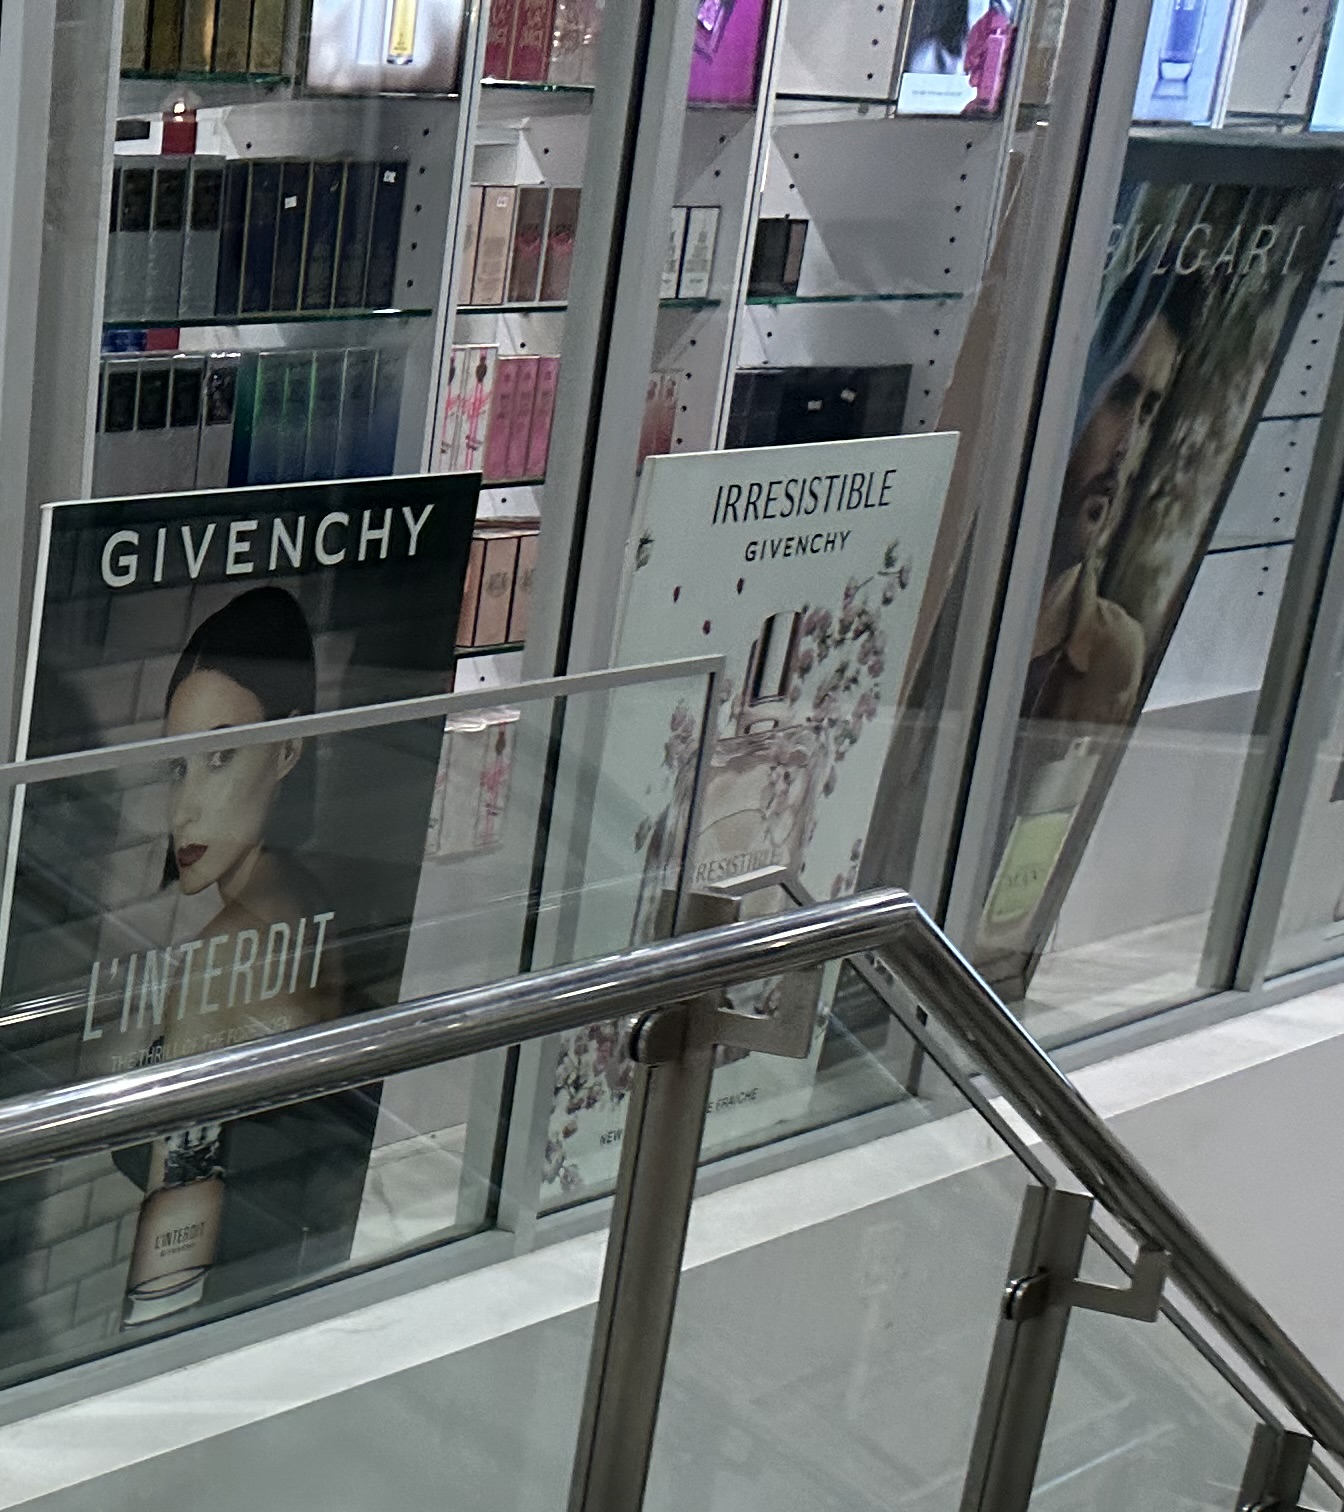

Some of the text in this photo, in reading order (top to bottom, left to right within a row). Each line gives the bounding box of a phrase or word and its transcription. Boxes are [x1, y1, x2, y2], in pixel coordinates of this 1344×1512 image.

[712, 469, 898, 525] IRRESISTIBLE
[101, 503, 434, 588] GIVENCHY
[744, 530, 852, 562] GIVENCHY
[82, 911, 335, 1042] L'INTERDIT
